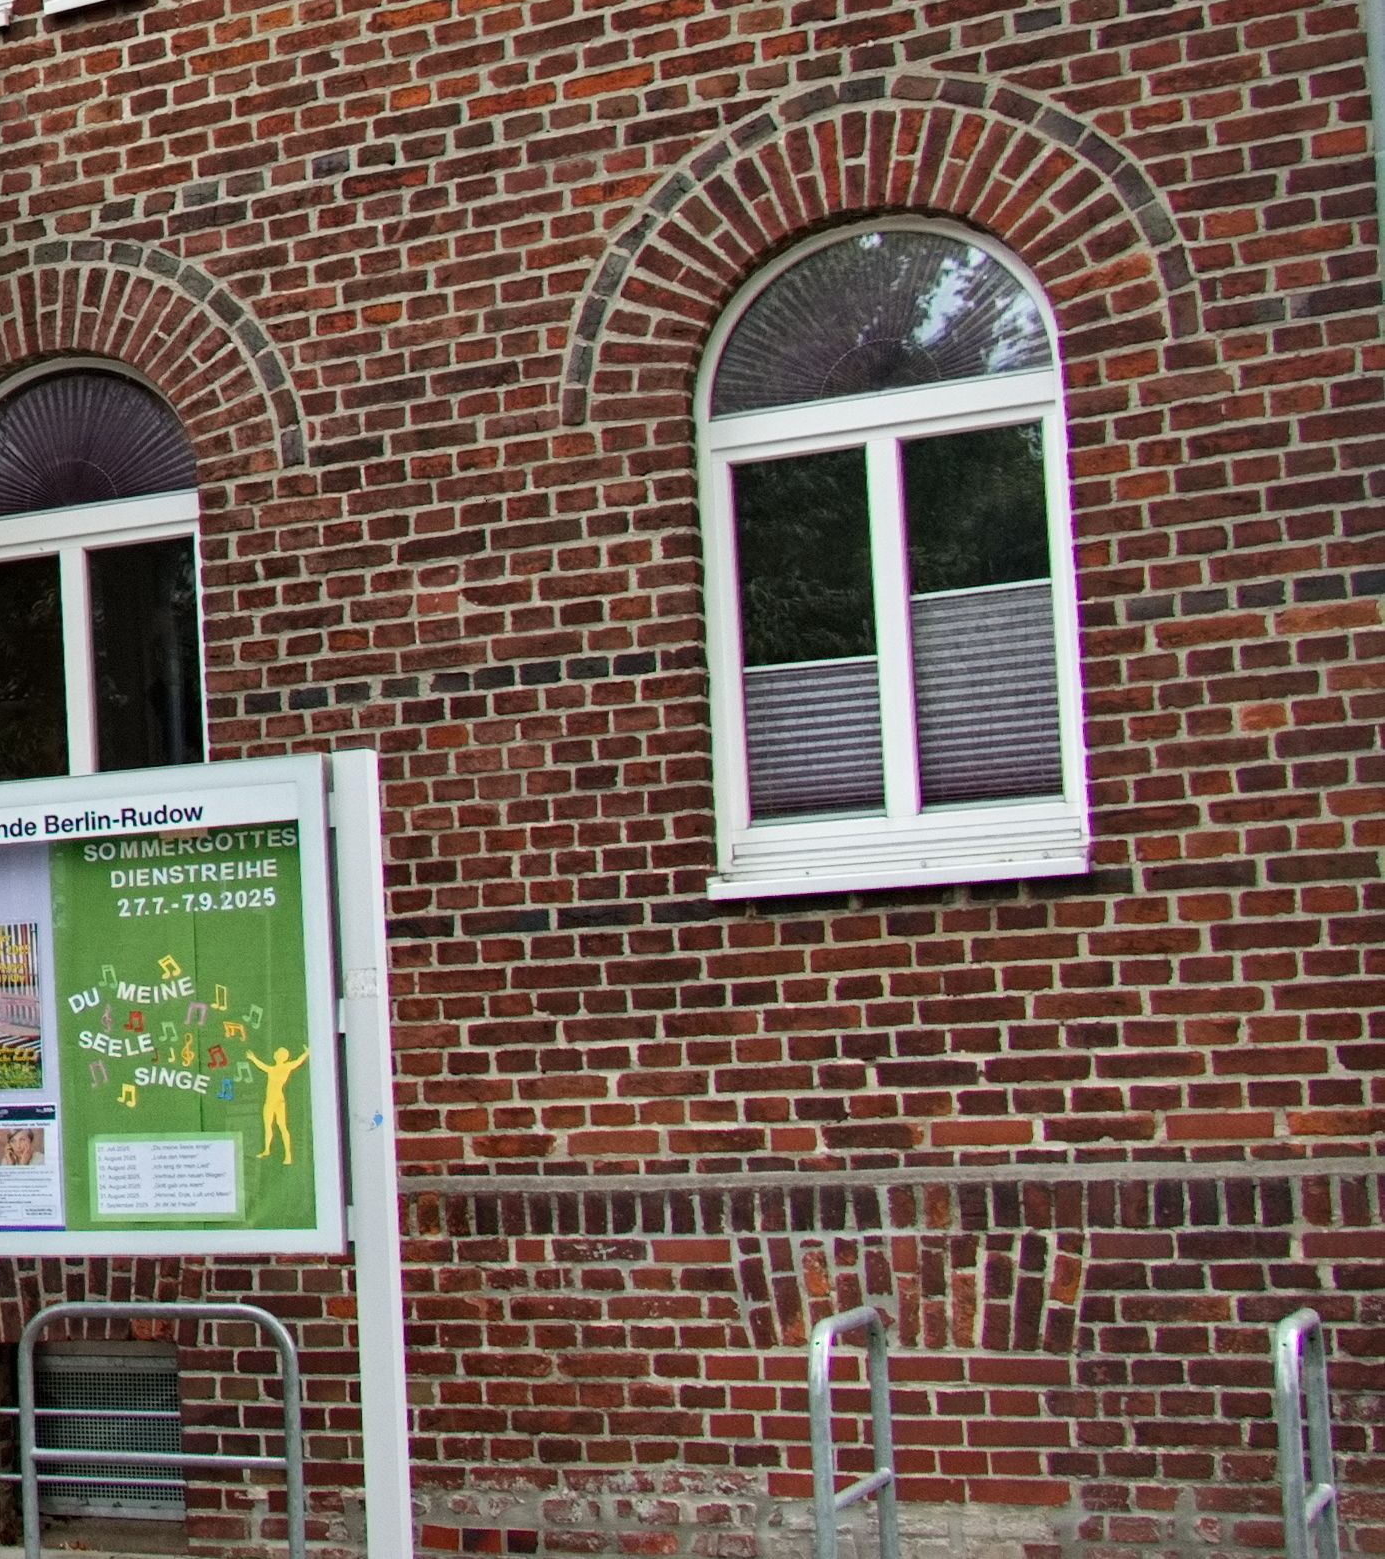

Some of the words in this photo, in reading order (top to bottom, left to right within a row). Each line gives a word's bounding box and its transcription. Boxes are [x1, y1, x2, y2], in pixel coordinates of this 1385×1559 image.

[44, 805, 204, 835] Berlin-Rudow
[83, 827, 297, 862] SOMMERGOTTES
[110, 858, 277, 889] DIENSTREIHE
[68, 987, 100, 1014] DU
[116, 976, 195, 1004] MEINE
[78, 1030, 155, 1058] SEELE
[134, 1066, 210, 1094] SINGE
[108, 1164, 126, 1172] August
[108, 1173, 127, 1181] August
[108, 1192, 126, 1200] August
